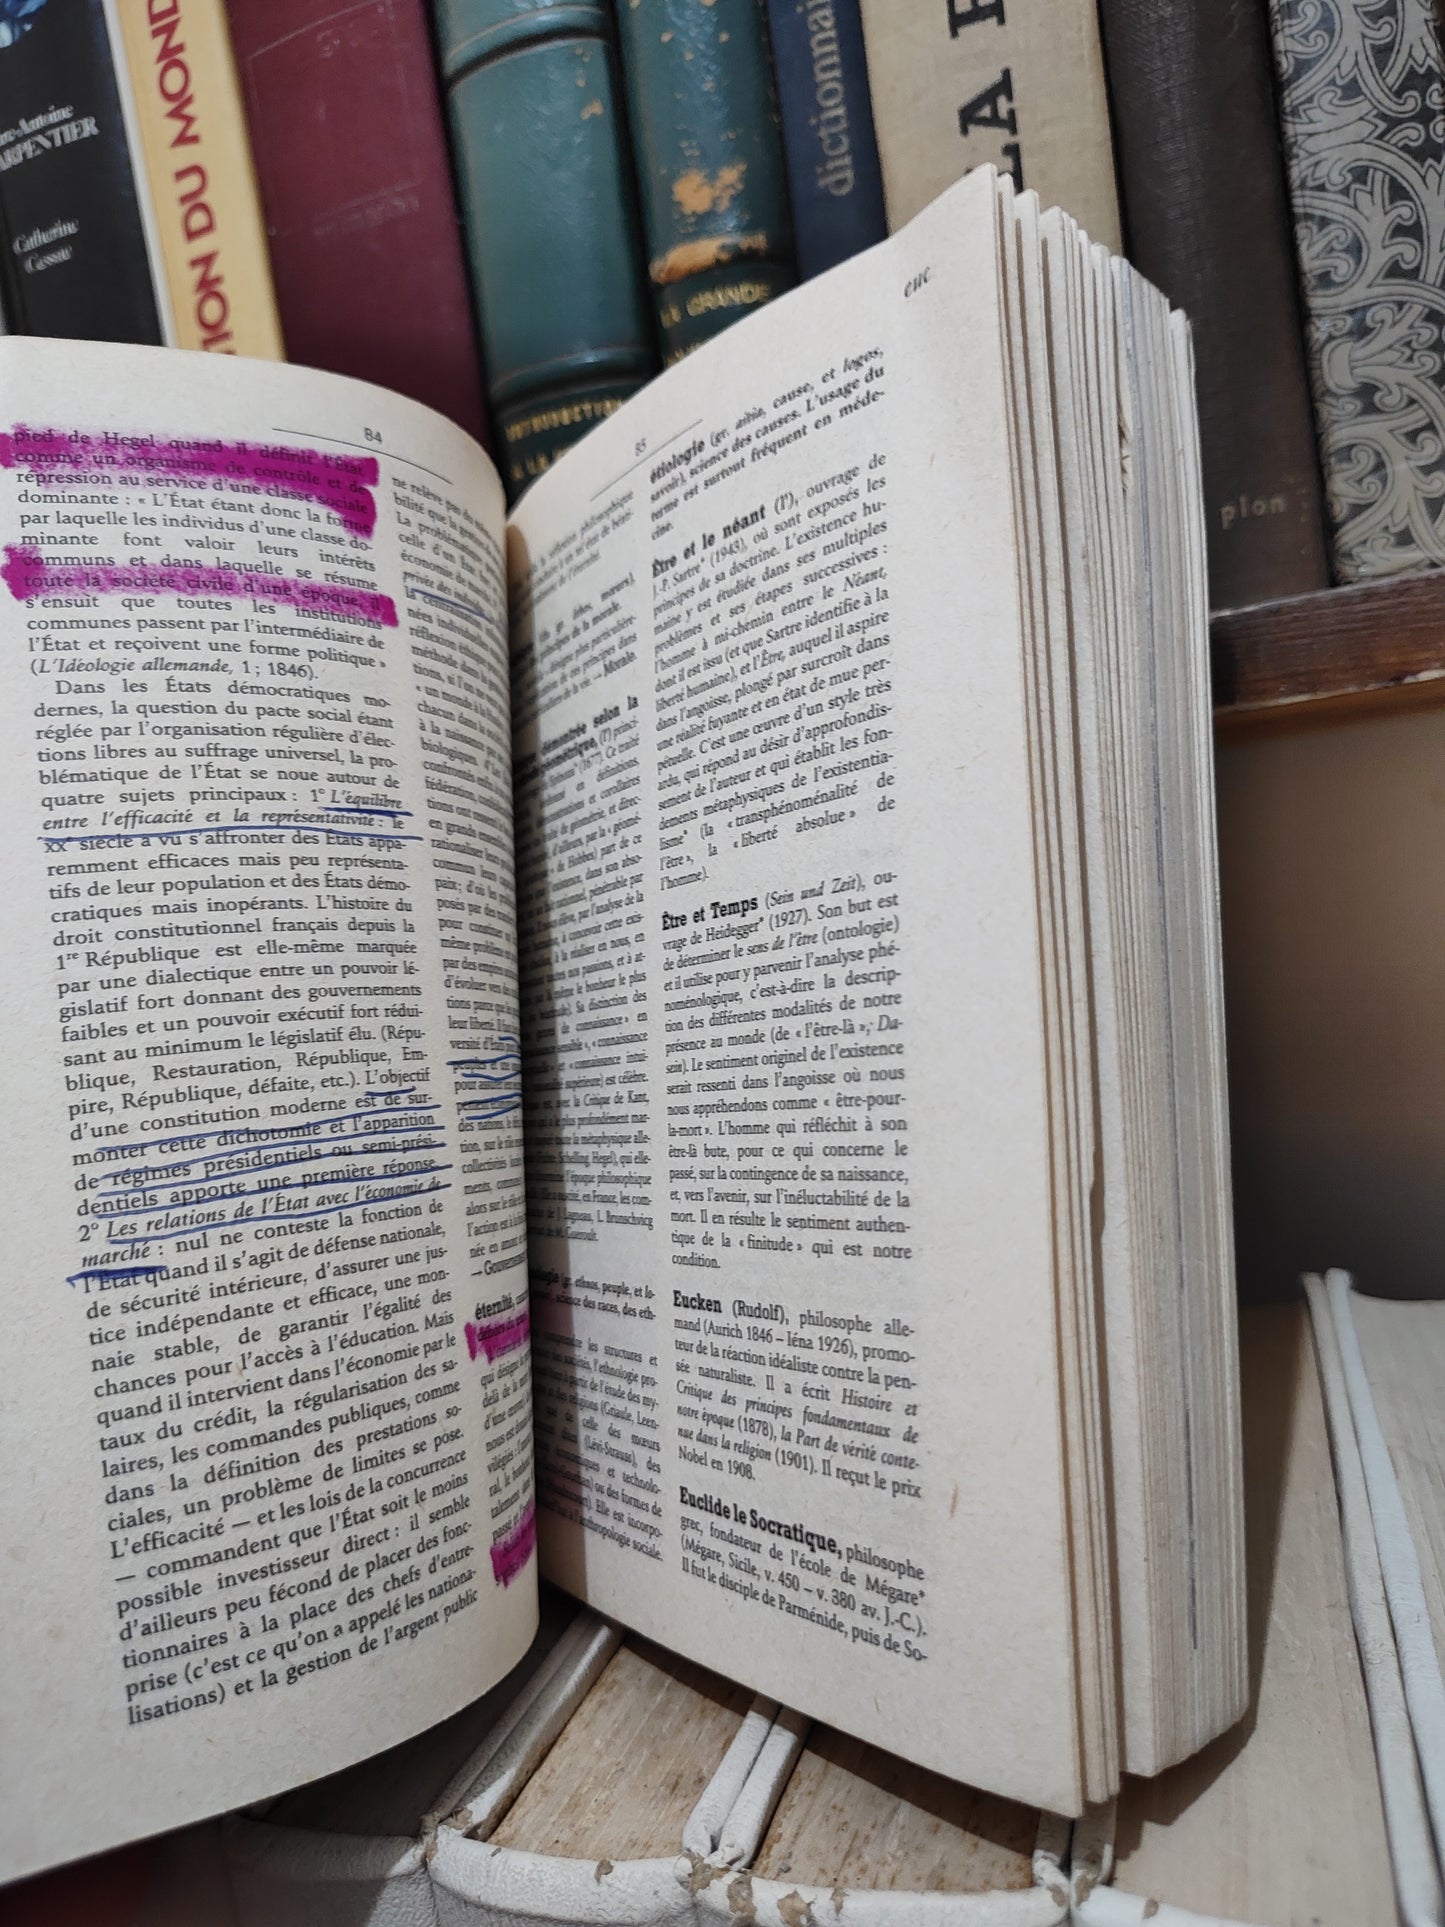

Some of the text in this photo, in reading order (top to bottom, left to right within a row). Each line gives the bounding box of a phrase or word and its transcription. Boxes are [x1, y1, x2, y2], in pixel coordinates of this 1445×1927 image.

[174, 164, 217, 244] DU
[188, 250, 236, 357] ION
[364, 427, 383, 444] 84
[684, 541, 696, 559] et
[702, 532, 715, 549] le
[722, 503, 766, 539] néant
[806, 465, 860, 498] ouvrage
[868, 453, 886, 470] de
[1221, 494, 1286, 530] plon
[20, 532, 376, 572] minante font valoir leurs intérêts
[27, 617, 385, 650] communes passent par l'intermédiaire de
[30, 657, 135, 675] (L'Idéologie
[141, 657, 234, 675] allemande,
[268, 661, 319, 680] 1846).
[34, 701, 393, 729] dernes, la question du pacte social étant
[38, 743, 398, 771] tions libres au suffrage universel, la pro-
[47, 853, 409, 877] remment efficaces mais peu représenta-
[51, 895, 412, 924] cratiques mais inopérants. L'histoire du
[661, 872, 897, 931] Être et Temps (Sein und Zeit), ou-
[86, 944, 200, 969] République
[215, 944, 242, 957] est
[257, 939, 345, 956] elle-même
[357, 939, 418, 957] marquée
[61, 1002, 424, 1043] faibles et un pouvoir exécutif fort rédui-
[65, 1046, 429, 1093] blique, Restauration, République, Em-
[667, 1068, 905, 1095] serait ressenti dans l'angoisse où nous
[704, 1145, 730, 1161] bute,
[737, 1146, 764, 1161] pour
[771, 1147, 785, 1157] ce
[792, 1142, 814, 1161] qui
[822, 1144, 885, 1157] concerne
[894, 1140, 908, 1156] le
[671, 1209, 911, 1233] mort. Il en résulte le sentiment authen-
[86, 1246, 448, 1320] de sécurité intérieure, d'assurer une jus-
[91, 1289, 453, 1372] naie stable, de garantir l'égalité des
[673, 1289, 915, 1337] Eucken (Rudolf), philosophe alle-
[679, 1445, 756, 1481] Nobel en 1908.
[679, 1485, 925, 1581] Euclide le Socratique, philosophe
[122, 1546, 474, 1669] tionnaires à la place des chefs d'entre-
[682, 1557, 928, 1661] Il fut le disciple de Parménide, puis de So-
[127, 1589, 479, 1725] lisations) et la gestion de l'argent public
